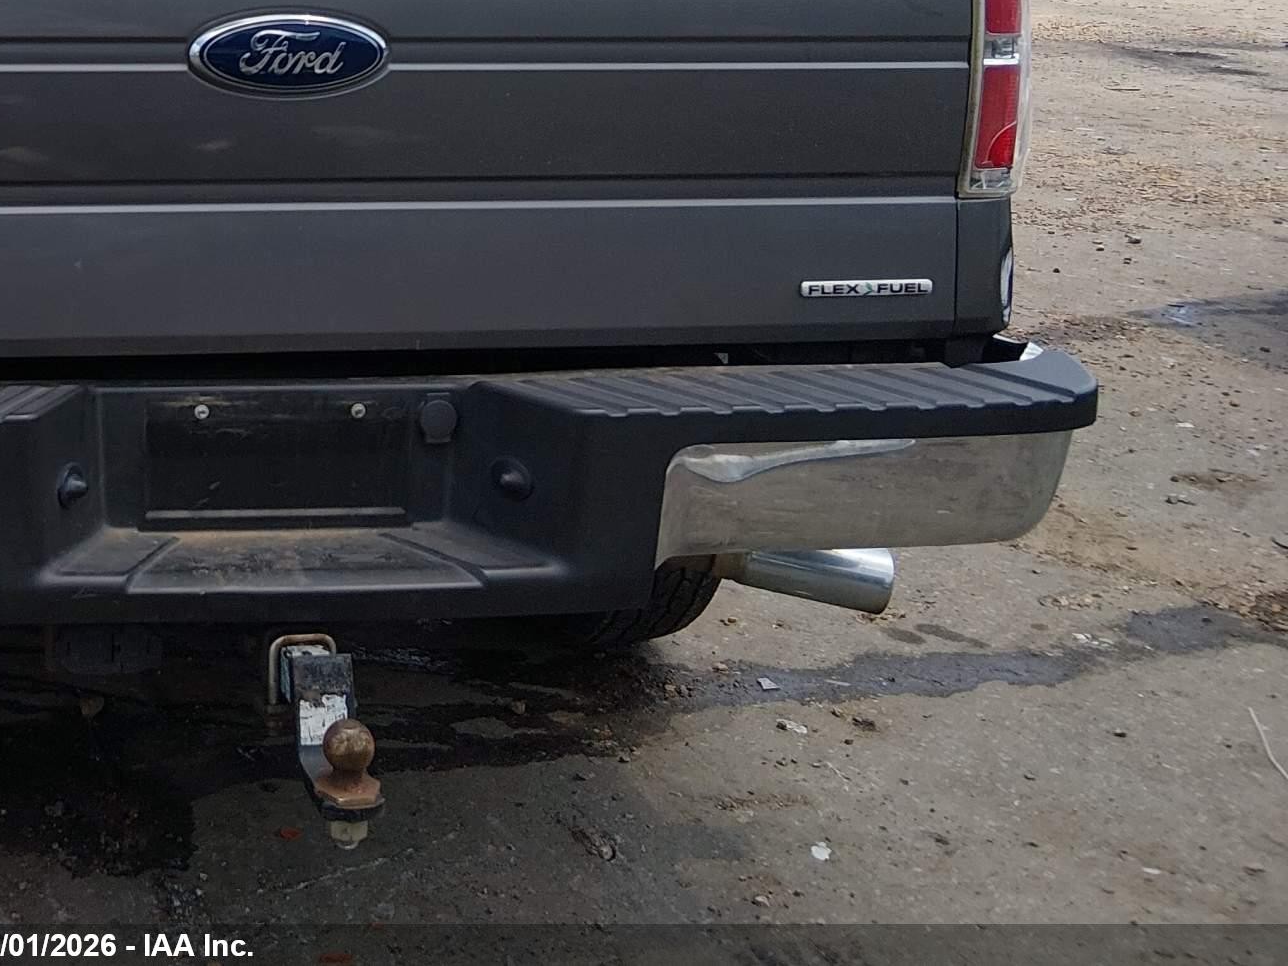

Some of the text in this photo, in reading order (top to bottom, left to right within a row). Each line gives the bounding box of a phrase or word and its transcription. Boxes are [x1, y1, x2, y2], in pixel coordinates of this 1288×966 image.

[238, 29, 347, 75] Ford
[808, 282, 929, 296] FLEX FUEL
